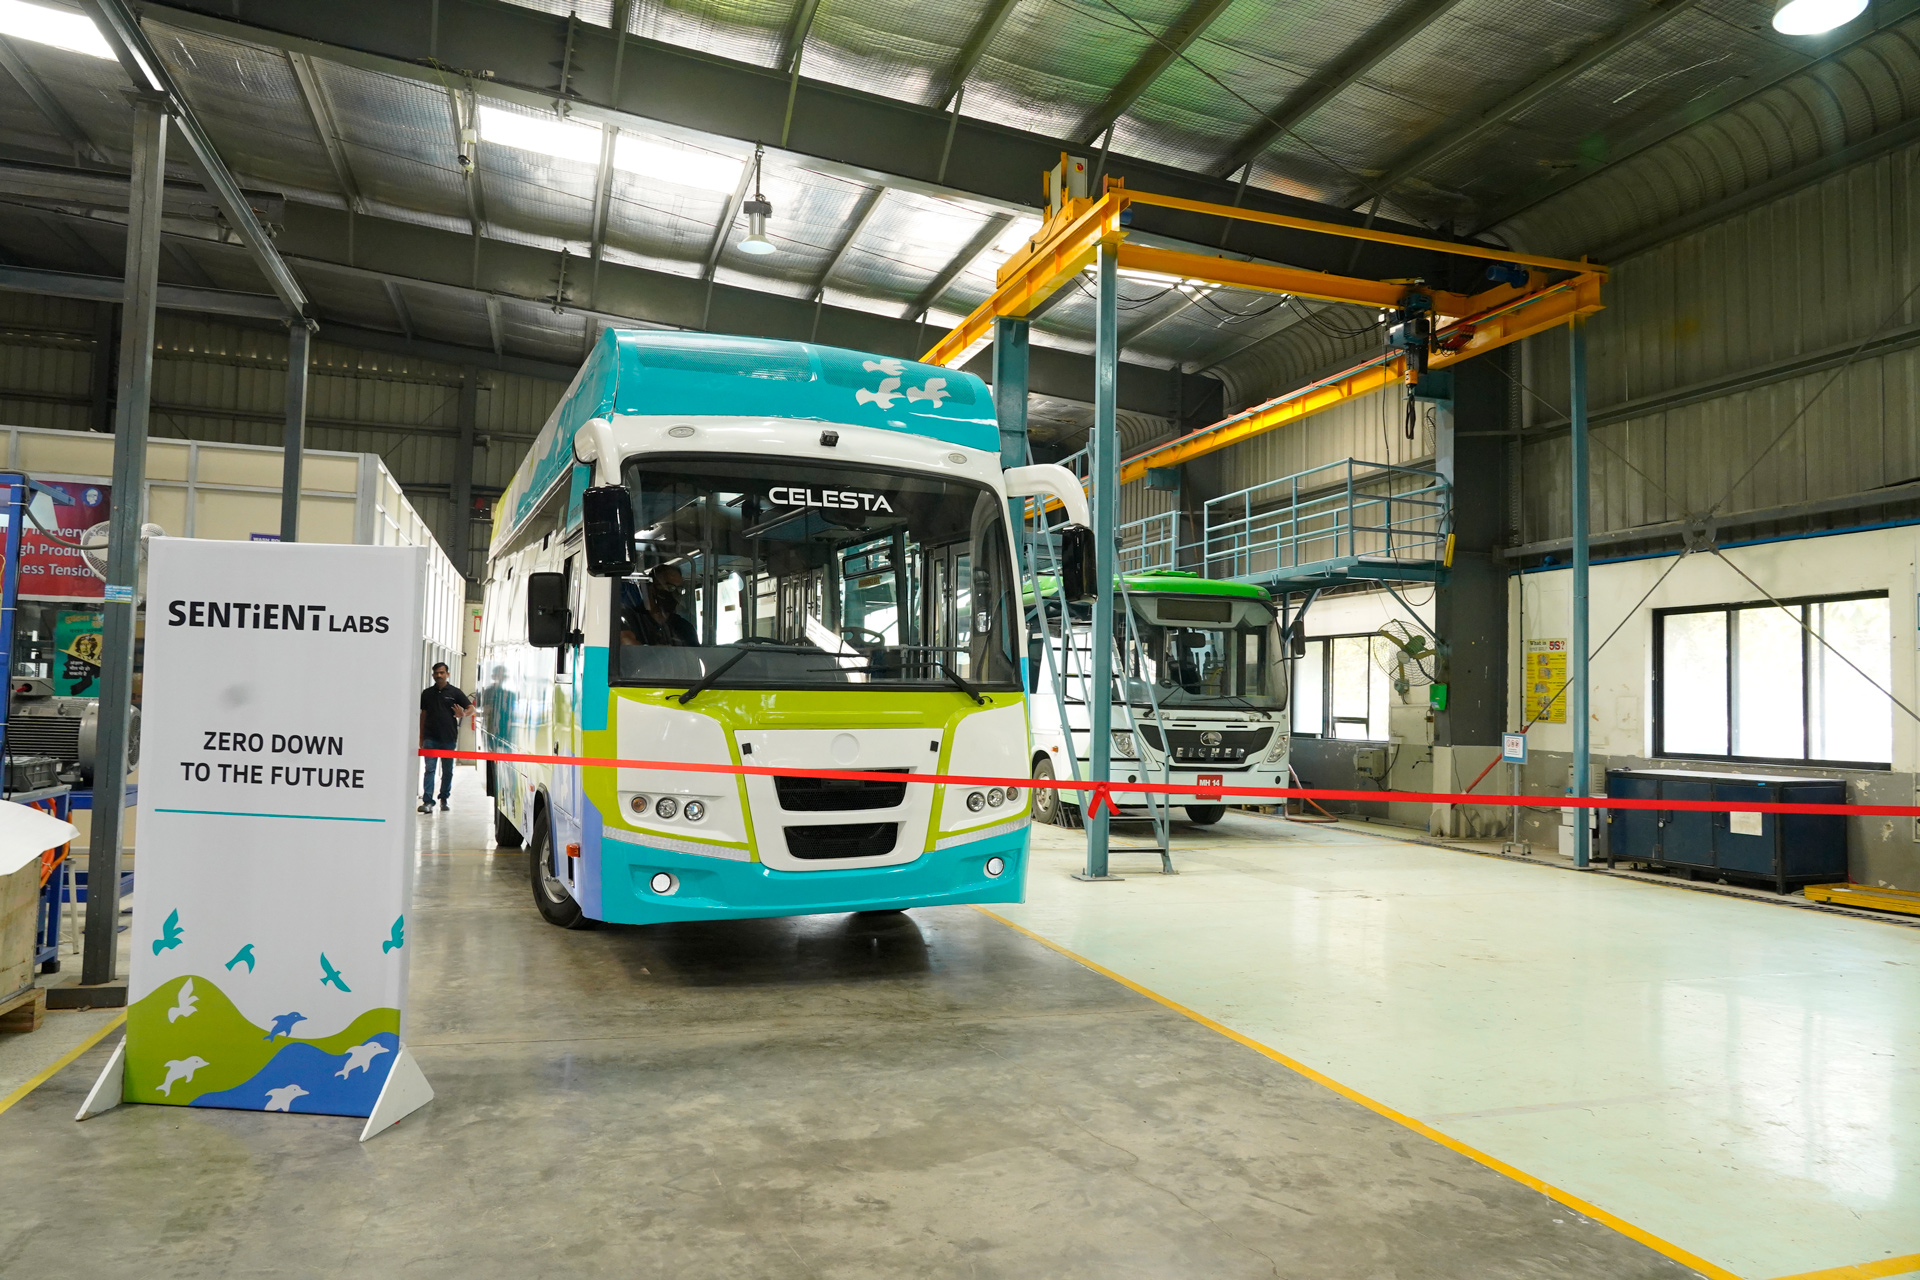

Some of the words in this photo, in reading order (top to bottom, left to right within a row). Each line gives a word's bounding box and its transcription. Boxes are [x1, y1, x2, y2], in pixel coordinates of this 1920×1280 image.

[768, 486, 894, 513] CELESTA
[20, 564, 45, 574] ess
[329, 614, 390, 633] LABS
[203, 731, 264, 752] ZERO
[271, 734, 343, 755] DOWN
[1176, 747, 1245, 758] EICHER
[180, 762, 211, 782] TO
[217, 763, 264, 784] THE
[271, 766, 365, 788] FUTURE
